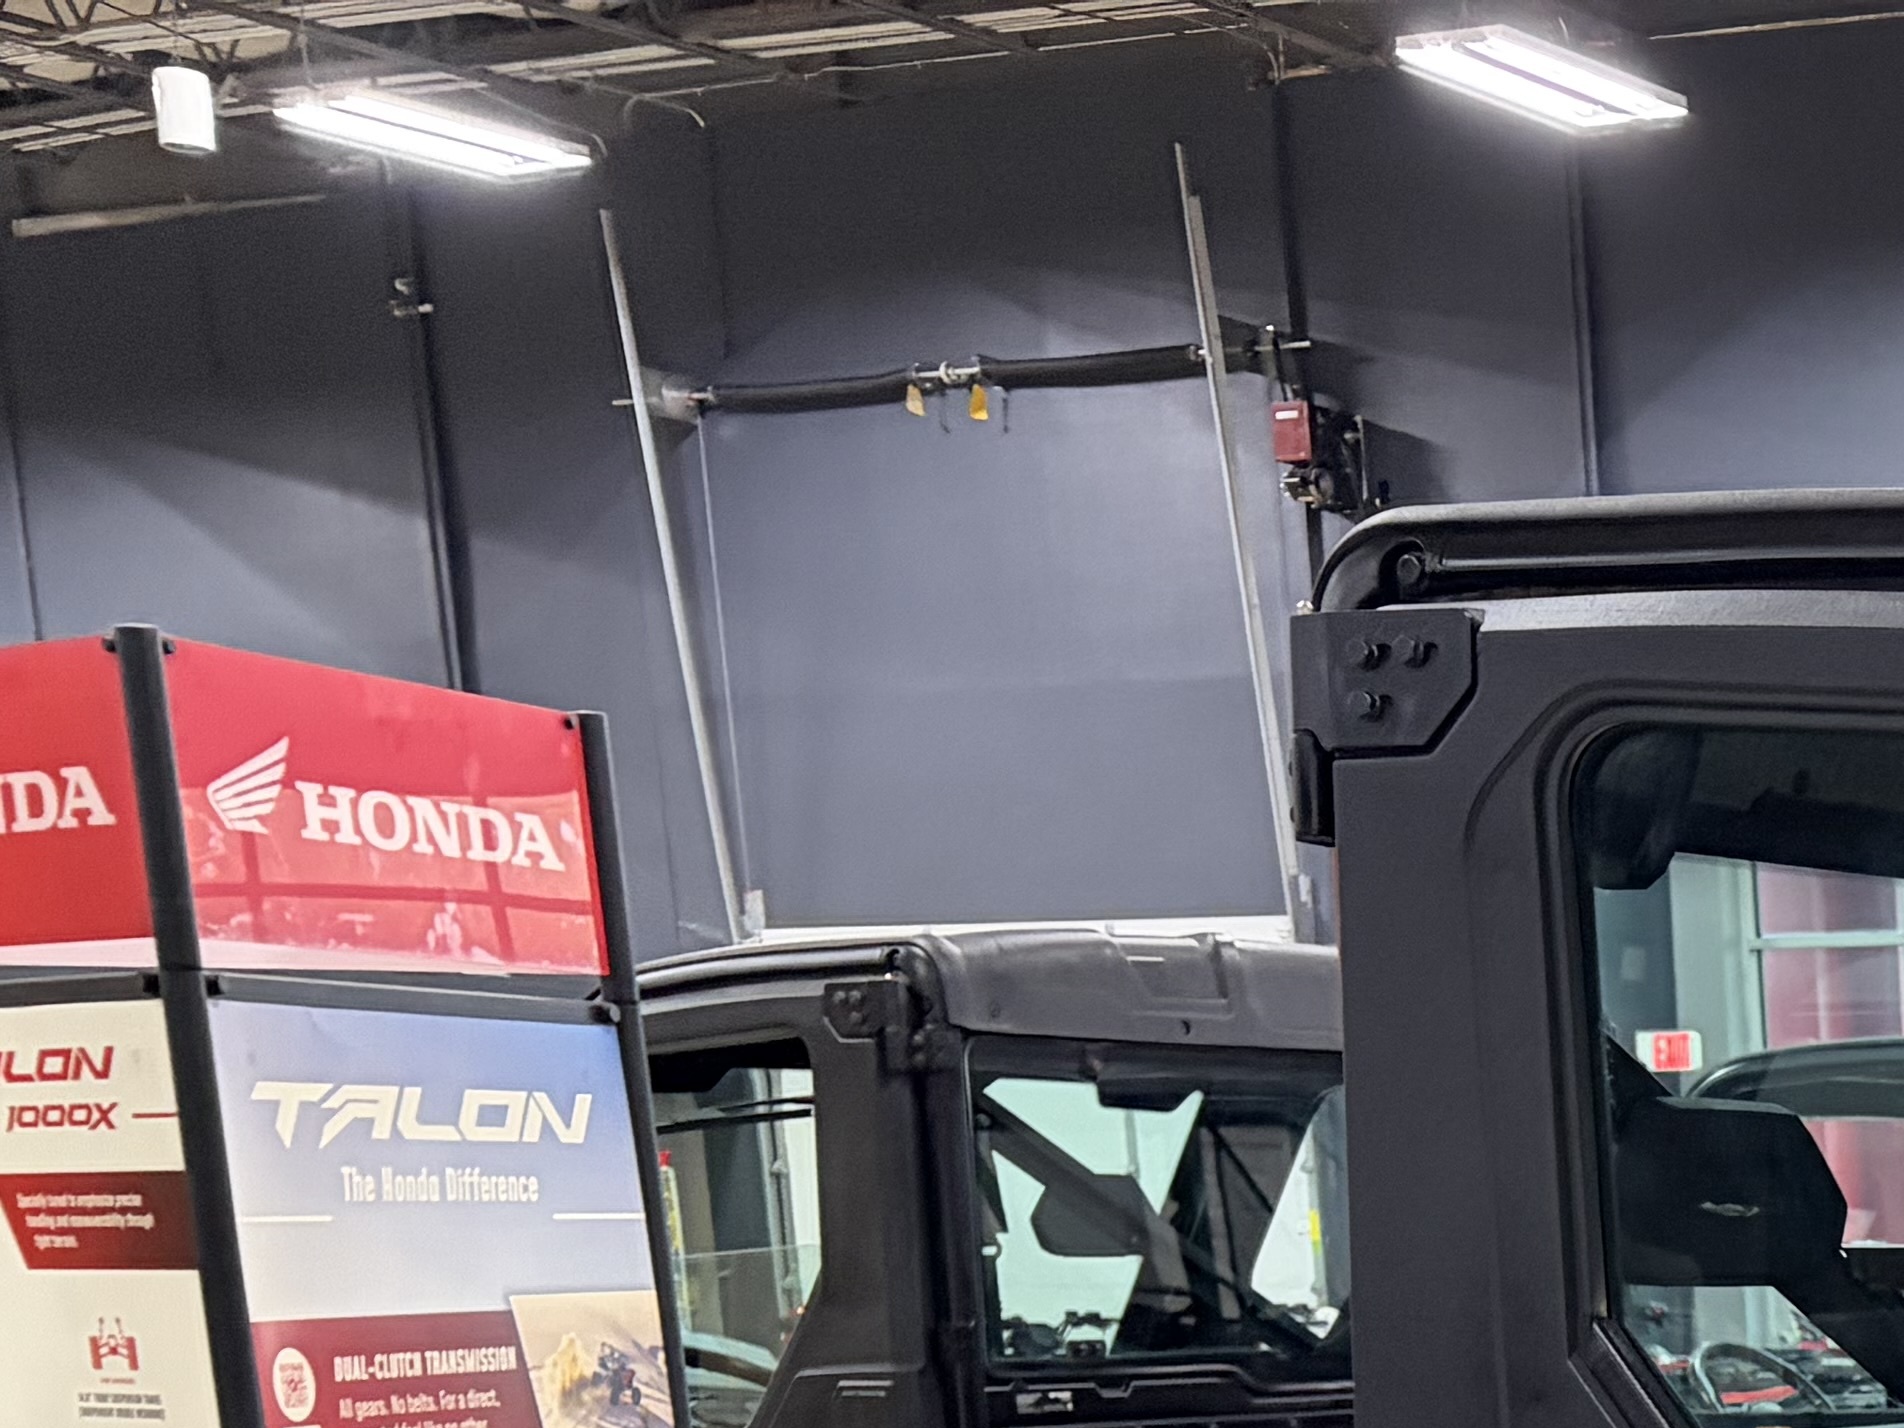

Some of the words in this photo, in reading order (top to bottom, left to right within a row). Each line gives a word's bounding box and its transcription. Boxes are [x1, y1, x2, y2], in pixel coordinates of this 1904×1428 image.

[0, 766, 116, 834] DA
[295, 781, 566, 872] HONDA
[0, 1046, 114, 1083] LON
[250, 1081, 592, 1149] TALON
[341, 1166, 375, 1201] The
[382, 1166, 440, 1201] Honda
[445, 1166, 539, 1202] Difference
[334, 1352, 422, 1382] DUAL-CLUTCH
[424, 1346, 517, 1374] TRANSMISSION
